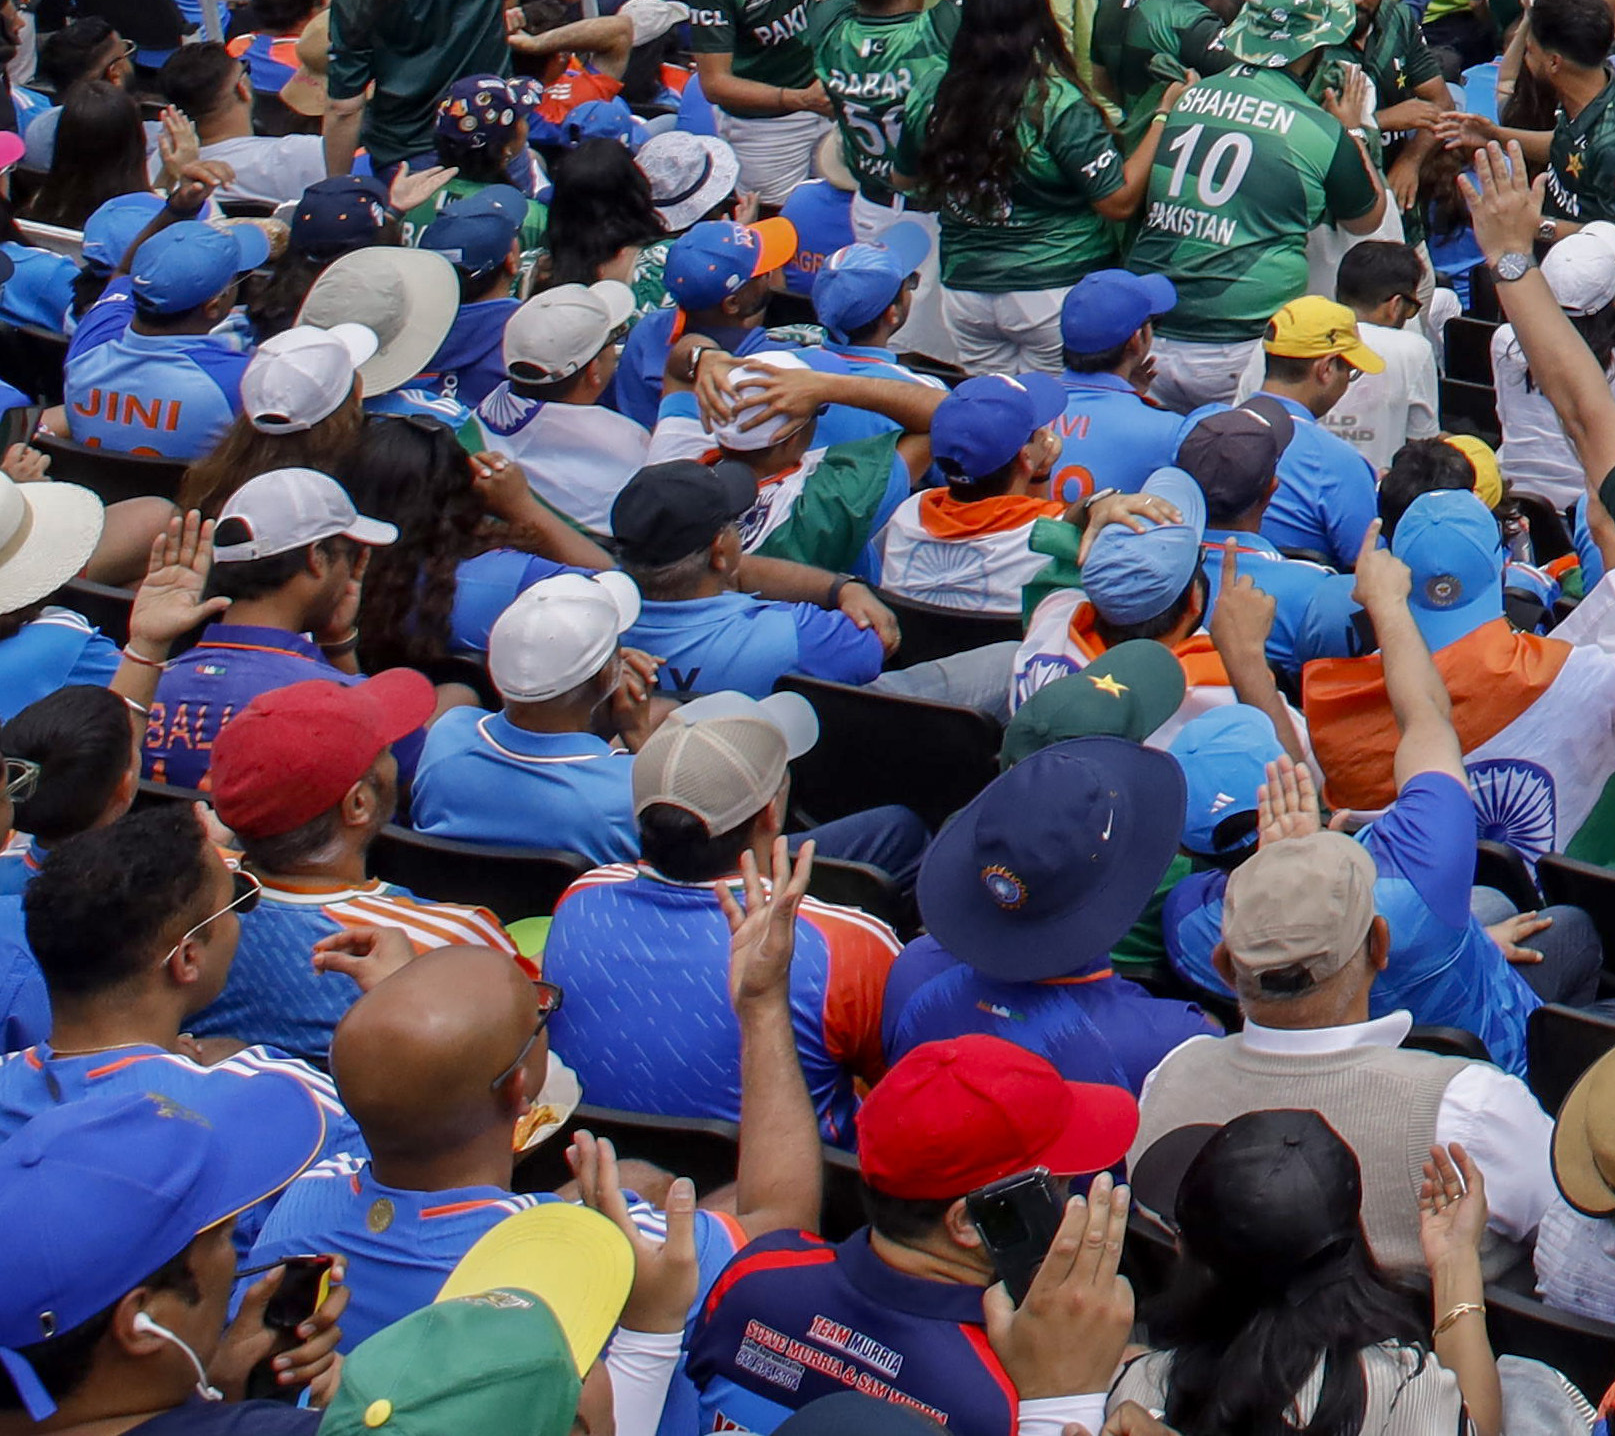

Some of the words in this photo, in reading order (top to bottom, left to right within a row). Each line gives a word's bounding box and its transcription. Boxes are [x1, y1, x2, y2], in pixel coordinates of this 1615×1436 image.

[828, 68, 911, 102] BABAR
[1177, 83, 1296, 135] SHAHEEN
[1167, 122, 1255, 208] 10
[1145, 204, 1237, 247] PAKISTAN
[74, 387, 183, 433] JINI
[745, 1319, 789, 1354] STEVE
[788, 1335, 842, 1378] MURRIA
[842, 1363, 858, 1387] &
[857, 1373, 889, 1401] SAM
[807, 1315, 850, 1350] TEAM
[849, 1331, 904, 1376] MURRIA
